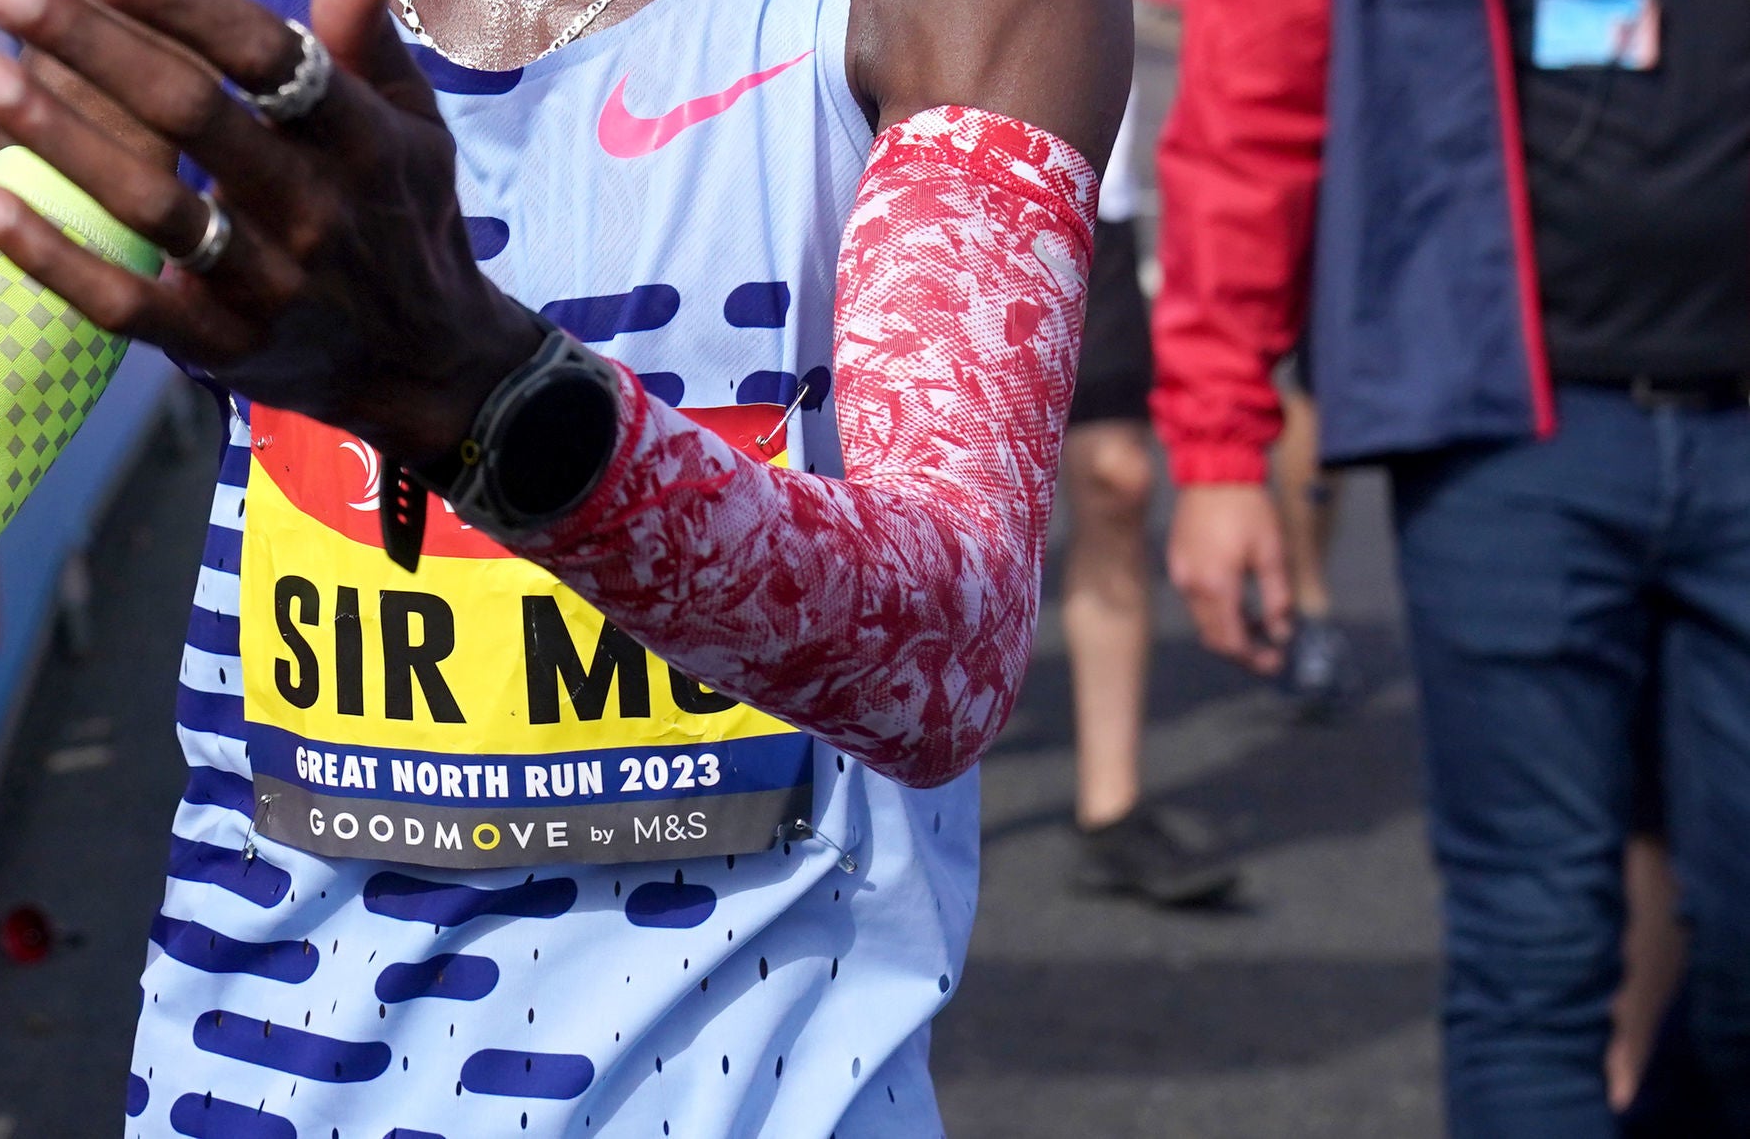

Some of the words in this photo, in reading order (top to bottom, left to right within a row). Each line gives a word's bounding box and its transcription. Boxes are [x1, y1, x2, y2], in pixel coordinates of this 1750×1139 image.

[274, 574, 467, 724] SIR
[295, 745, 378, 790] GREAT
[391, 758, 510, 799] NORTH
[525, 760, 604, 799] RUN
[619, 753, 722, 793] 2023
[308, 807, 569, 851] GOODMOVE
[589, 825, 615, 845] by
[633, 811, 709, 845] M&S
